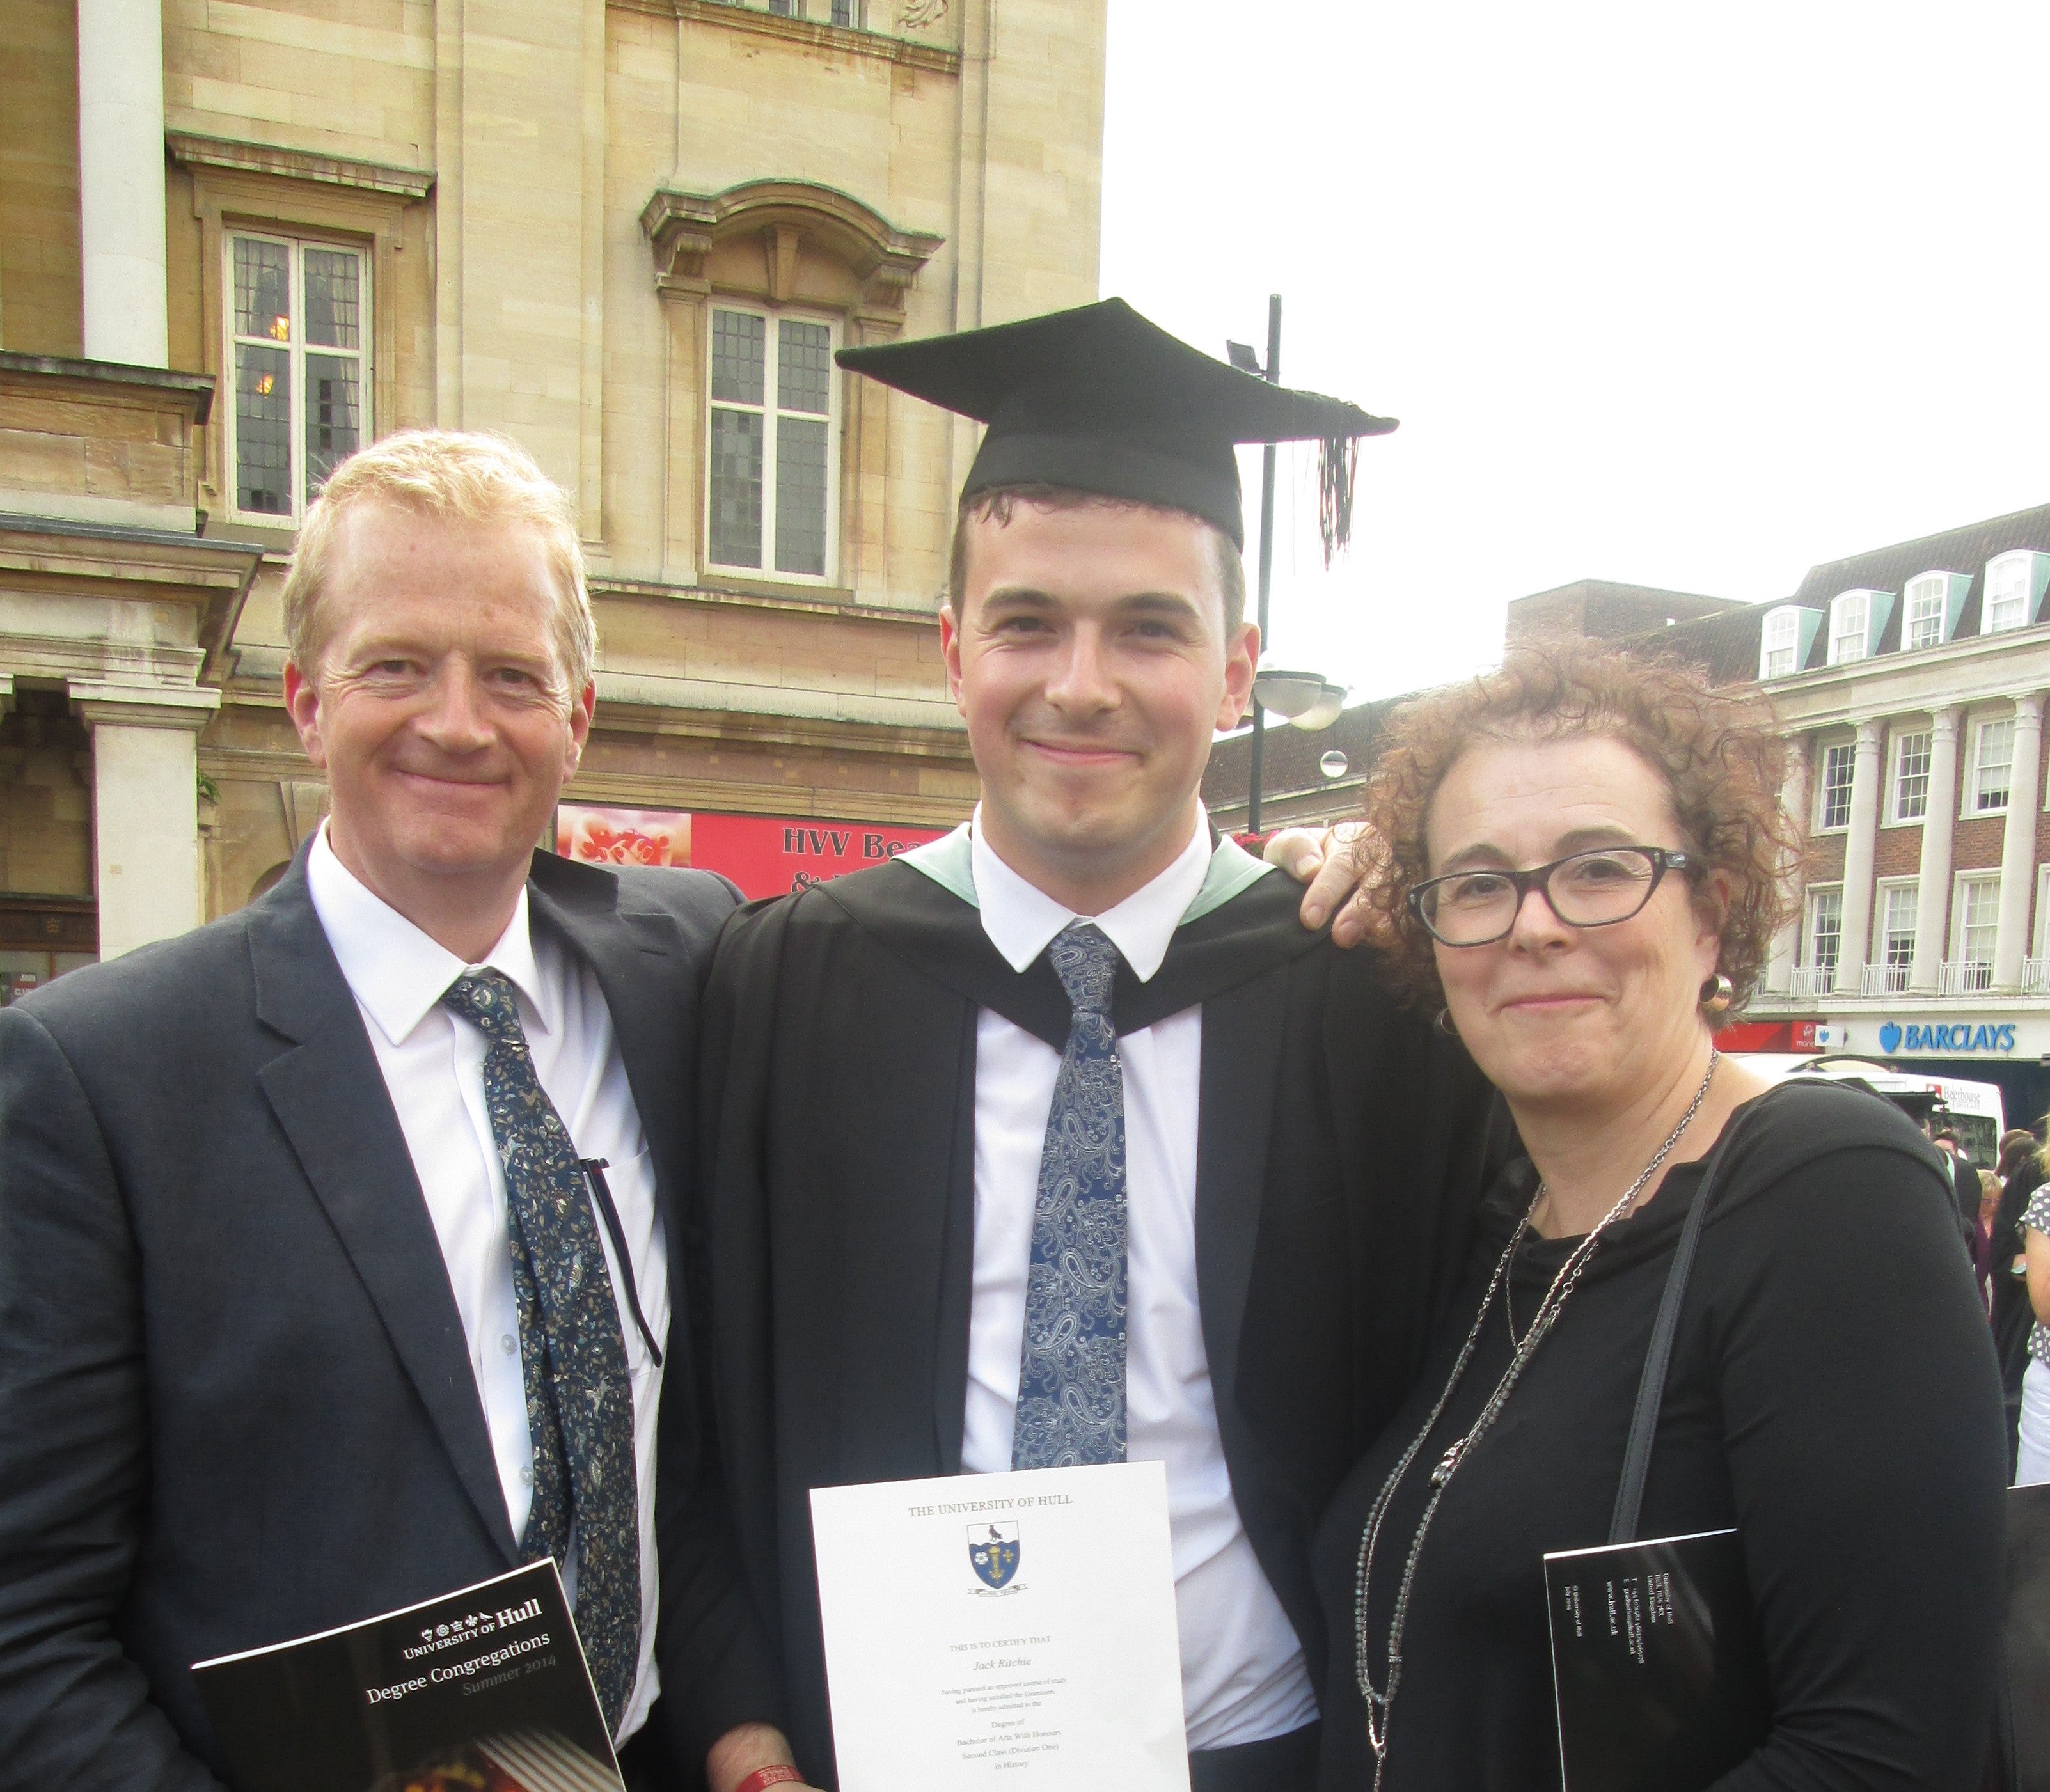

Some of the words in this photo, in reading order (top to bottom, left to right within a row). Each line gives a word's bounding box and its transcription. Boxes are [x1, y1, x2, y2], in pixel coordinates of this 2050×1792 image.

[791, 870, 821, 893] &
[1904, 1023, 2016, 1051] BARCLAYS
[908, 1506, 935, 1517] THE
[938, 1498, 1014, 1514] UNIVERSITY
[1018, 1497, 1034, 1507] OF
[1038, 1494, 1073, 1506] HULL
[1607, 1580, 1618, 1636] www.hull.ac.uk
[403, 1628, 478, 1660] UNIVERSITY
[480, 1622, 496, 1635] OF
[495, 1598, 542, 1629] Hull
[950, 1644, 968, 1652] THIS
[993, 1638, 1027, 1648] CERTIFY
[1029, 1635, 1051, 1644] THAT
[366, 1676, 427, 1704] Degree
[430, 1633, 551, 1683] Congregations
[973, 1660, 995, 1670] Jack
[998, 1657, 1032, 1668] Ritchie
[462, 1665, 521, 1696] Summer
[524, 1655, 557, 1674] 2014
[991, 1720, 1016, 1729] Degree
[957, 1737, 988, 1747] Bachelor
[1032, 1729, 1062, 1739] Honours
[962, 1750, 987, 1759] Second
[988, 1749, 1007, 1757] Class
[1009, 1747, 1040, 1756] (Division
[1003, 1760, 1029, 1770] History
